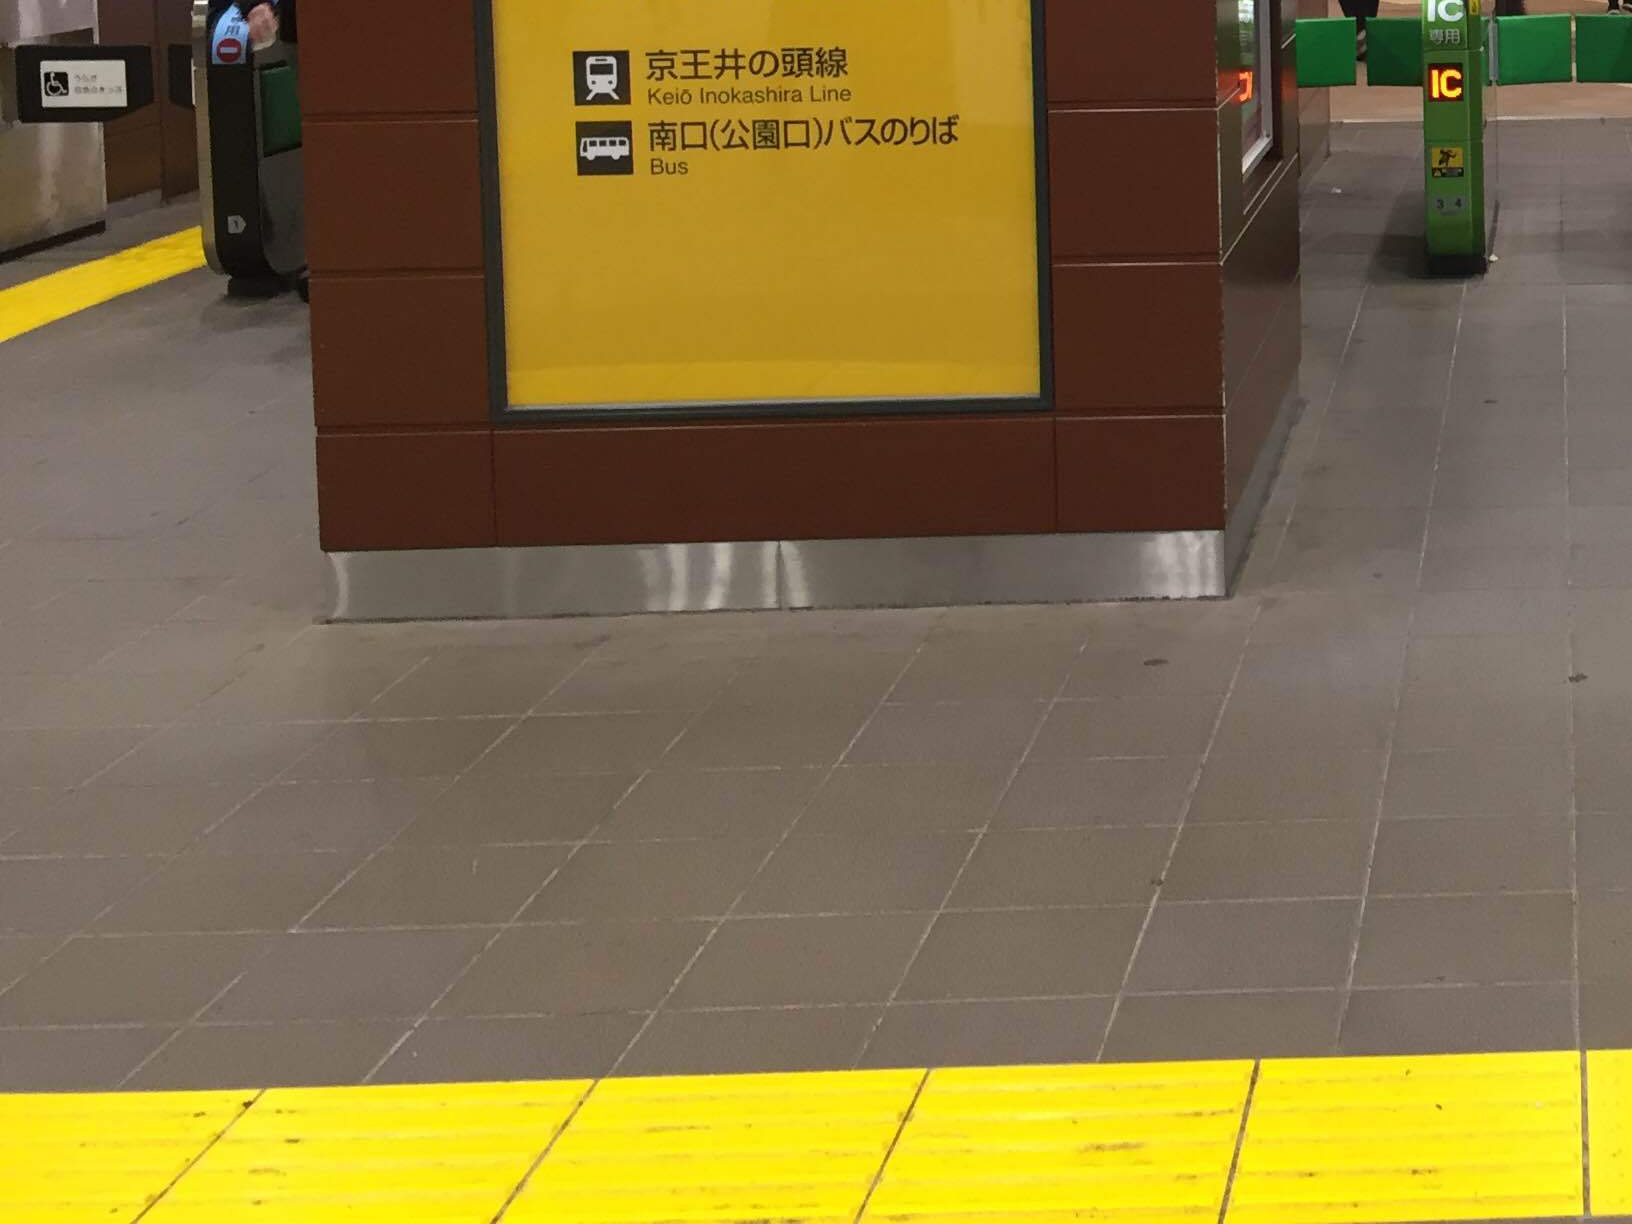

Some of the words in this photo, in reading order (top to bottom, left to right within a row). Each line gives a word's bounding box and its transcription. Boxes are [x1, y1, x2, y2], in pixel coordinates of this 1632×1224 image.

[645, 46, 850, 82] 京王井の頭線
[647, 87, 693, 106] Keiō
[700, 85, 803, 106] Inokashira
[810, 84, 852, 103] Line
[1430, 68, 1463, 99] IC
[647, 114, 960, 152] 南口(公園口)バスのりば
[649, 158, 689, 176] Bus
